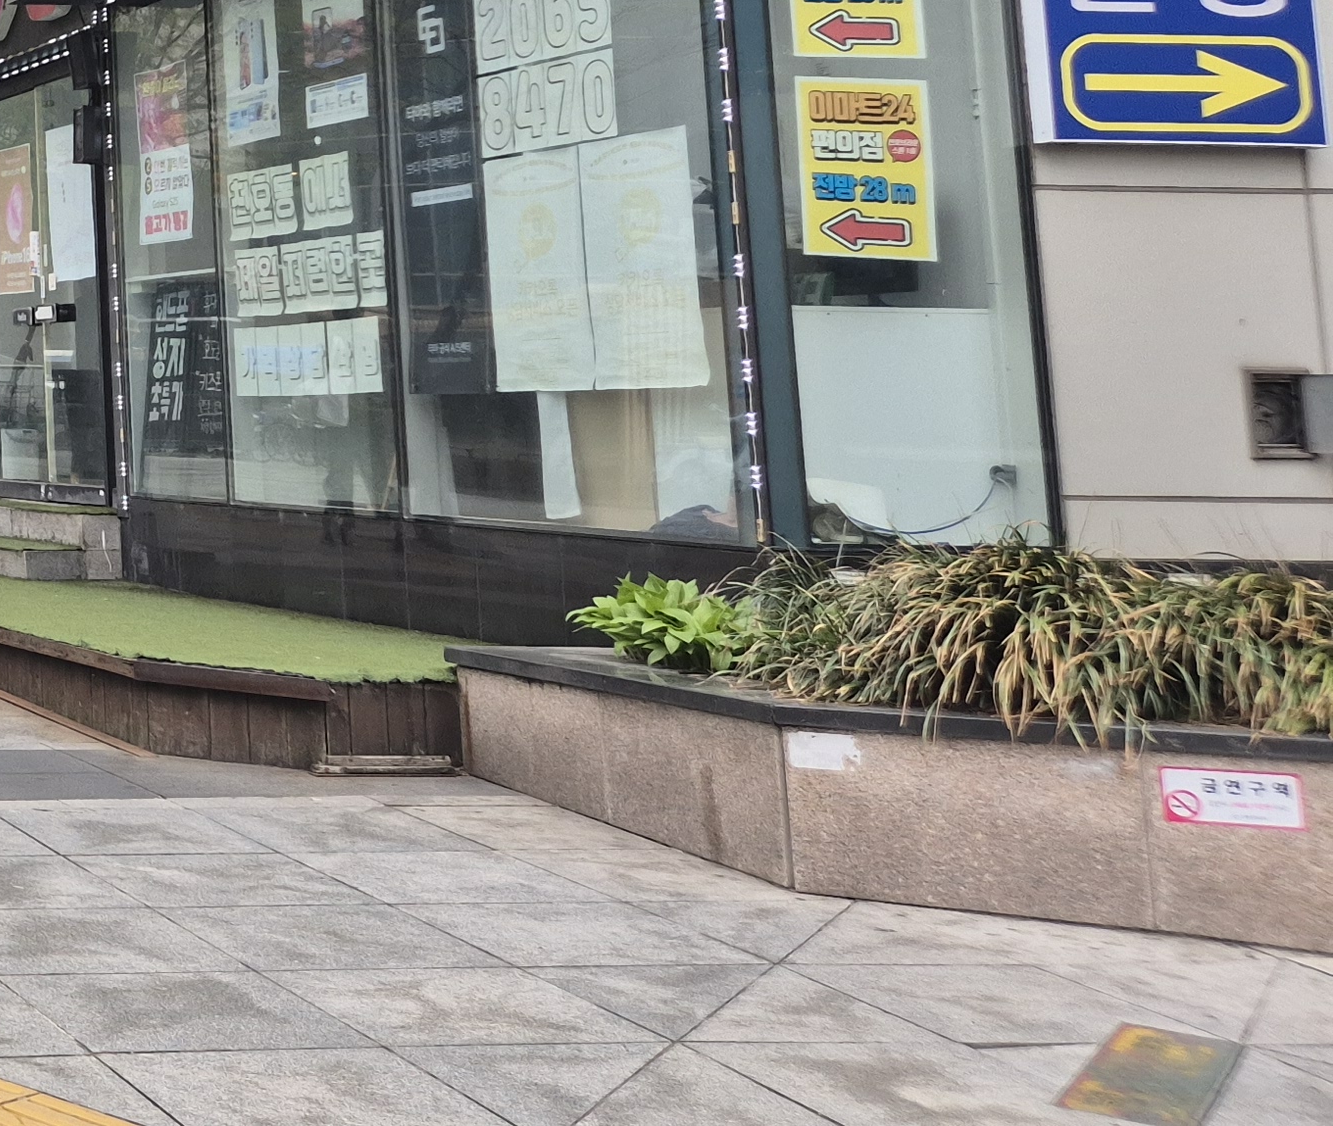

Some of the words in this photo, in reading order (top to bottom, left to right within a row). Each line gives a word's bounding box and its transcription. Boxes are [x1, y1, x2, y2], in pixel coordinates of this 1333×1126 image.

[482, 59, 618, 152] 8470
[808, 90, 916, 125] 이마트24
[810, 129, 885, 163] 편의점
[229, 170, 298, 227] 천호동
[303, 158, 352, 215] 에서
[811, 172, 859, 203] 전방
[858, 175, 889, 203] 28
[890, 183, 917, 205] m
[236, 254, 281, 302] 제일
[283, 240, 356, 299] 저렴한
[358, 238, 387, 291] 곳
[152, 336, 186, 379] 성지
[148, 381, 185, 422] 초특가
[1200, 776, 1291, 798] 금연구역
